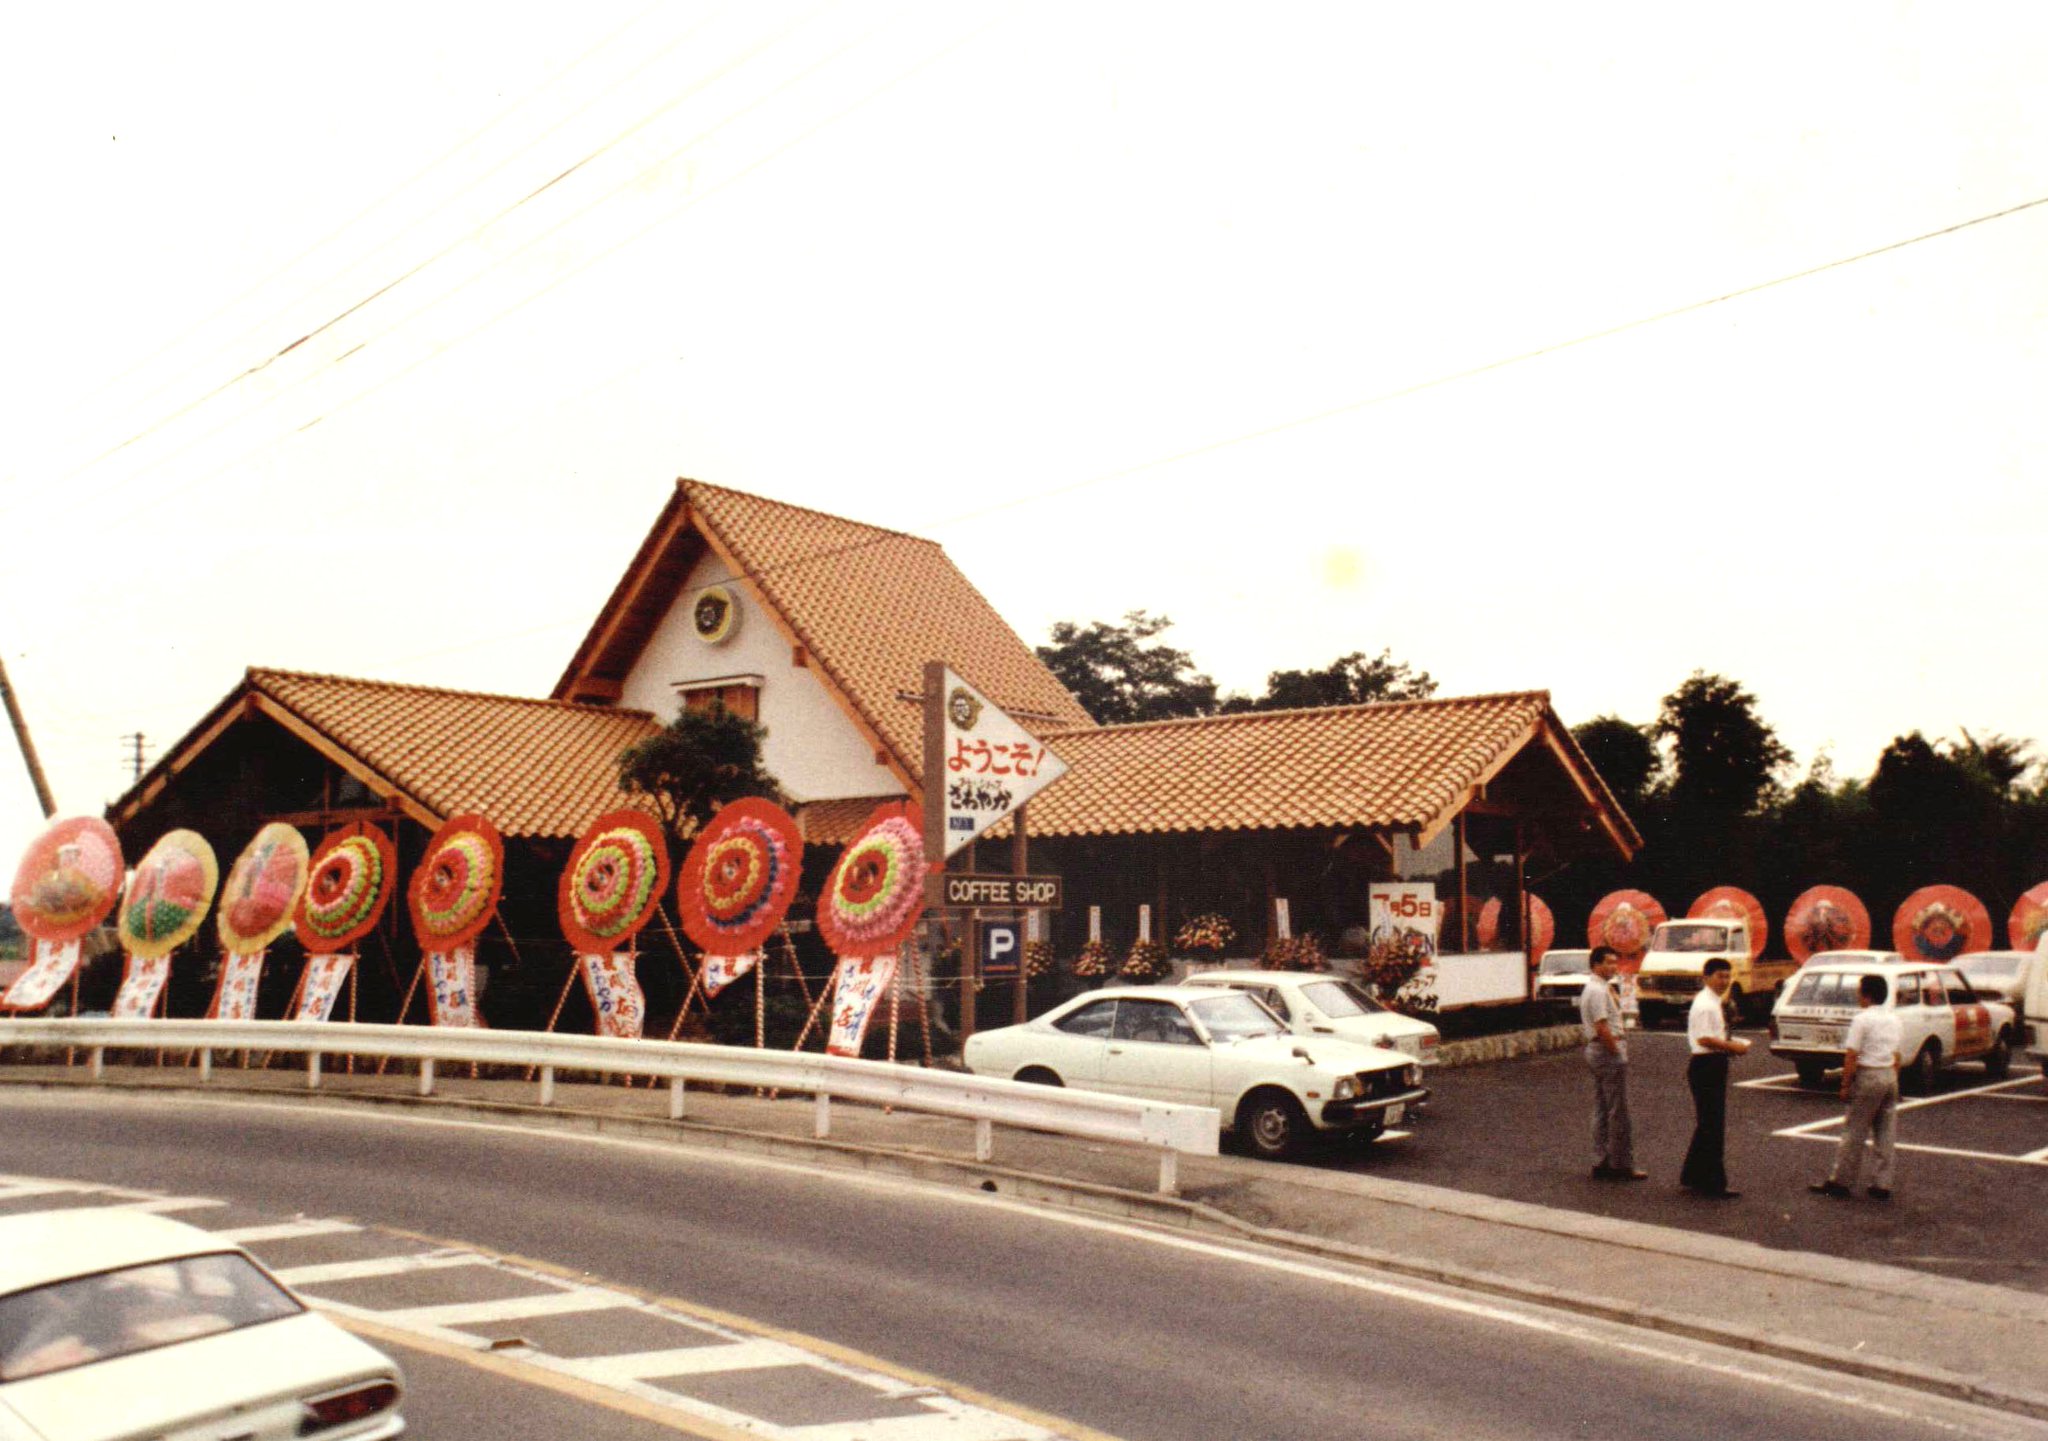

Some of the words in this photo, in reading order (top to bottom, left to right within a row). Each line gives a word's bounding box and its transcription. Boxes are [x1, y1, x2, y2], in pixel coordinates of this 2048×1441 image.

[948, 738, 1046, 777] ようこそ!
[948, 783, 1012, 811] さわやか
[949, 879, 1011, 903] COFFEE
[1015, 880, 1057, 903] SHOP
[989, 927, 1016, 960] P
